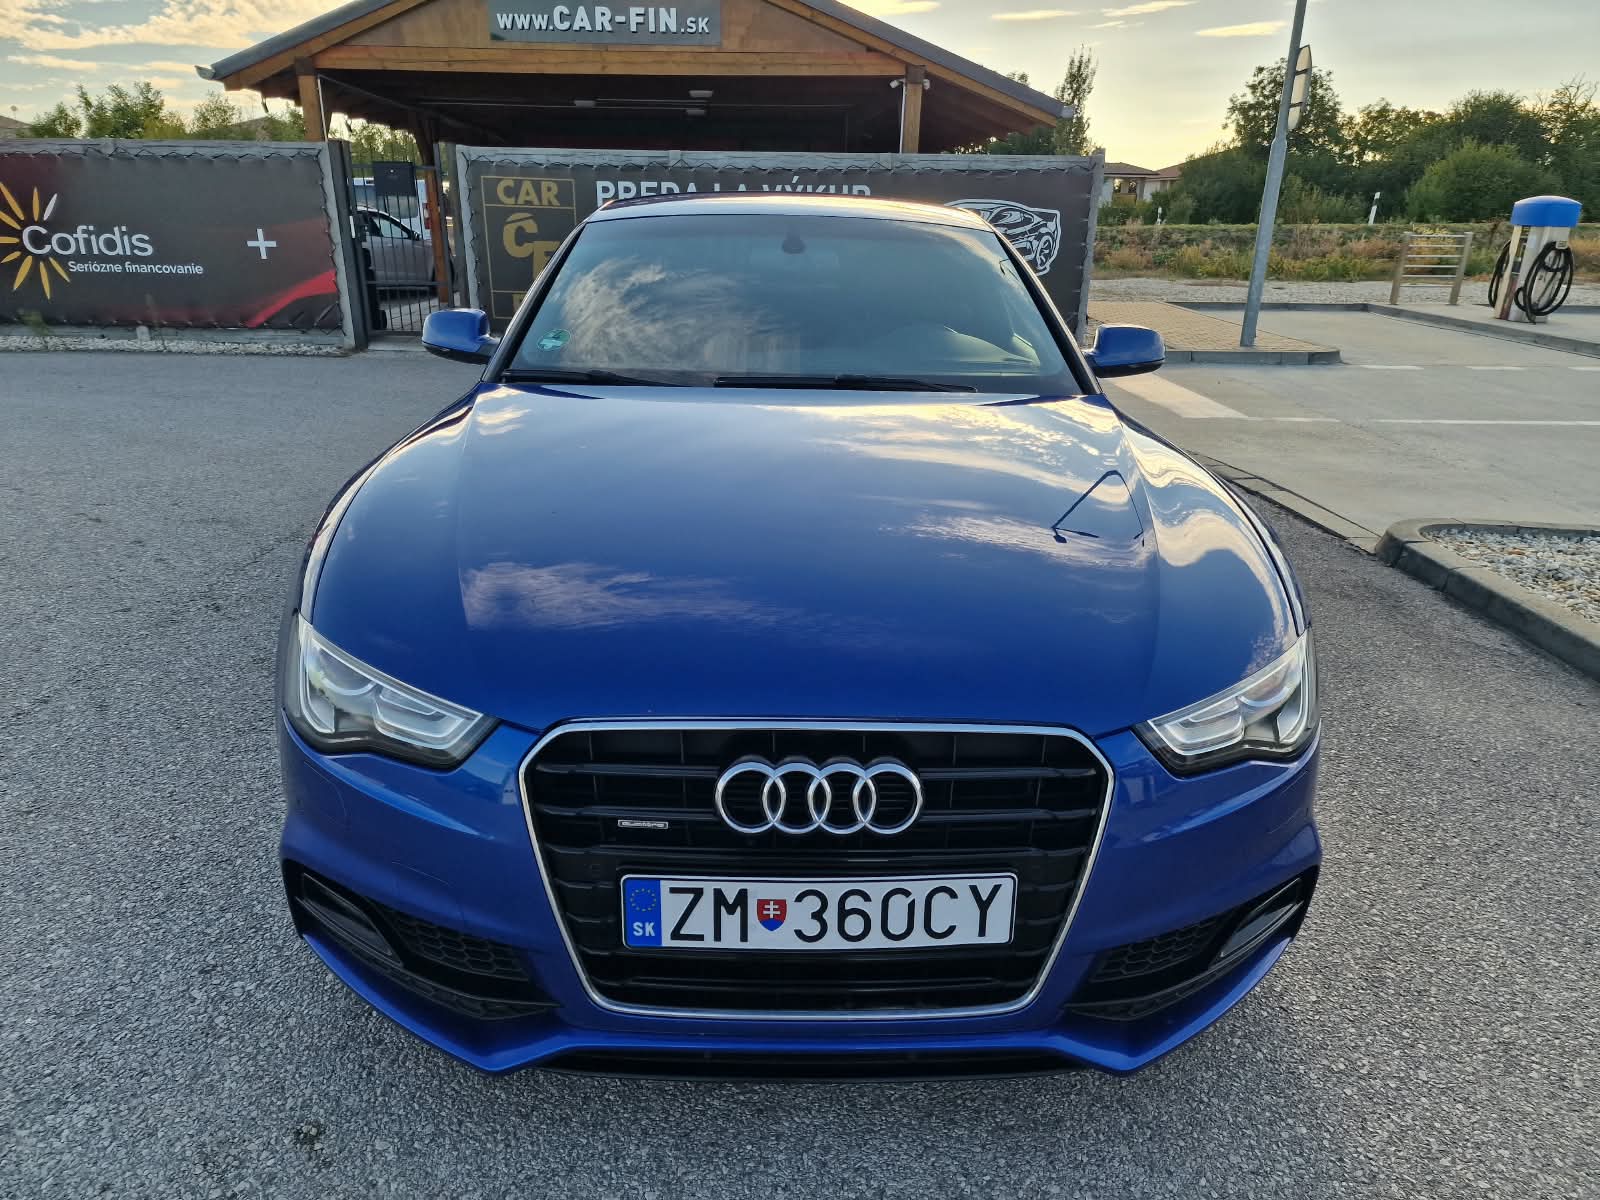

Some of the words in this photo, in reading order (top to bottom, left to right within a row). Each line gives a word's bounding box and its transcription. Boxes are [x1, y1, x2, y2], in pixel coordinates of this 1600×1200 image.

[496, 179, 561, 206] CAR
[22, 225, 154, 257] Cofidis
[68, 260, 123, 273] Seriózne
[125, 261, 204, 275] financovanie
[668, 886, 748, 943] ZM
[793, 883, 1003, 943] 360CY
[632, 921, 655, 937] SK
